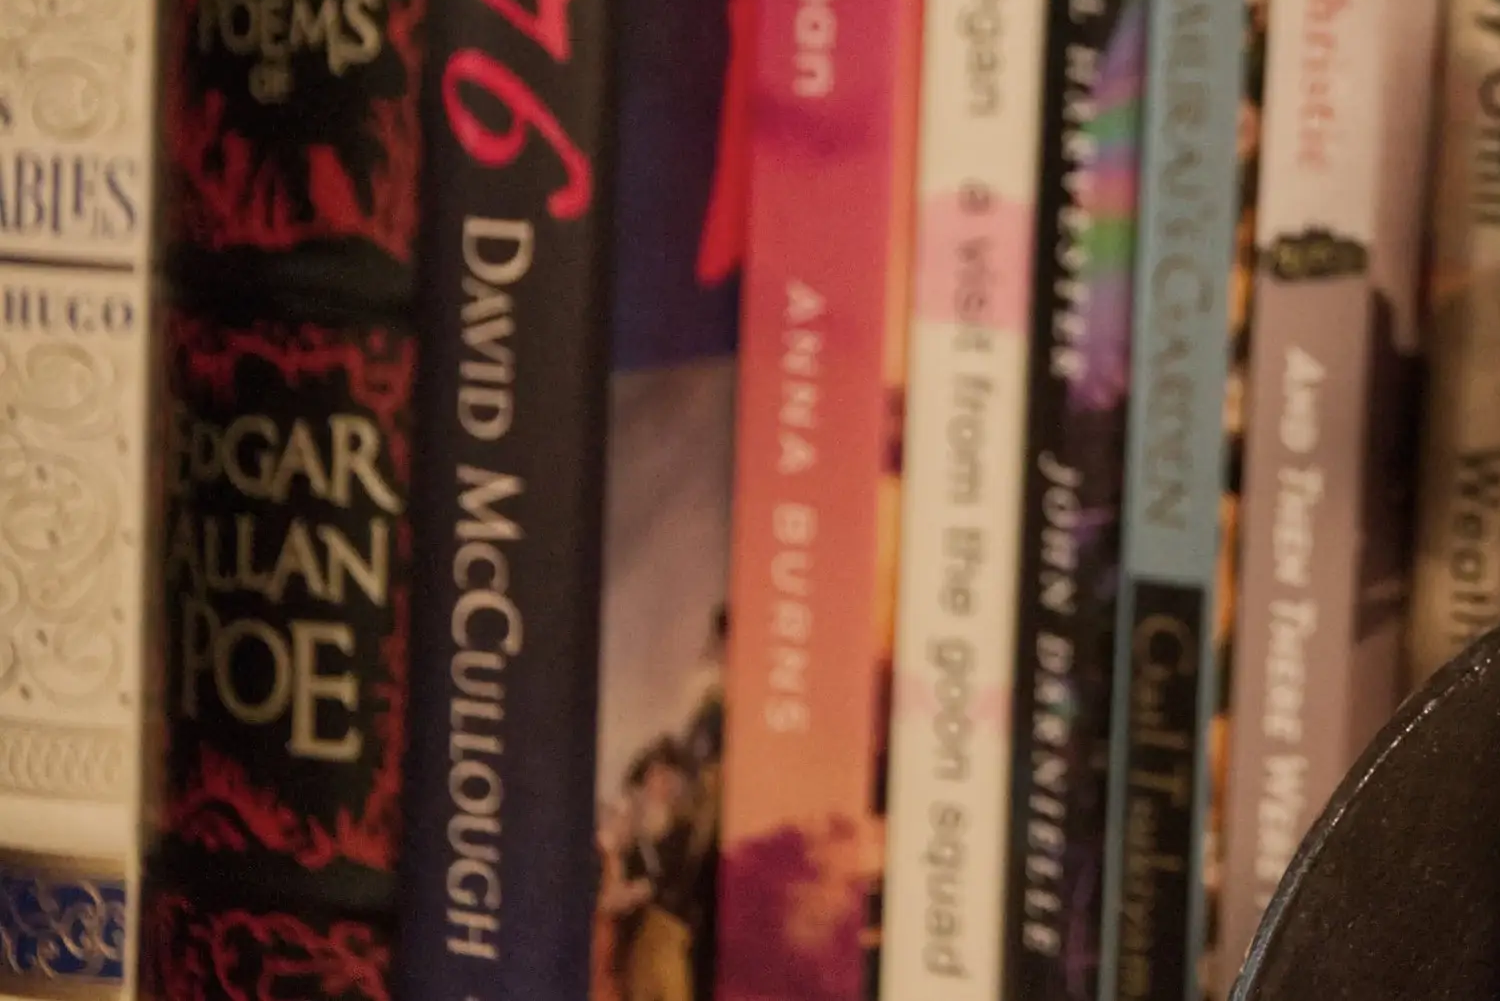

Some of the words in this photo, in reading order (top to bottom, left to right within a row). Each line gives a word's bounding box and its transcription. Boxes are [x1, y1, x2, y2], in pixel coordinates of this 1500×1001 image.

[457, 214, 534, 442] DAVID
[776, 278, 828, 474] ANNA
[945, 372, 994, 505] from
[182, 601, 365, 762] POE
[926, 632, 979, 783] goon
